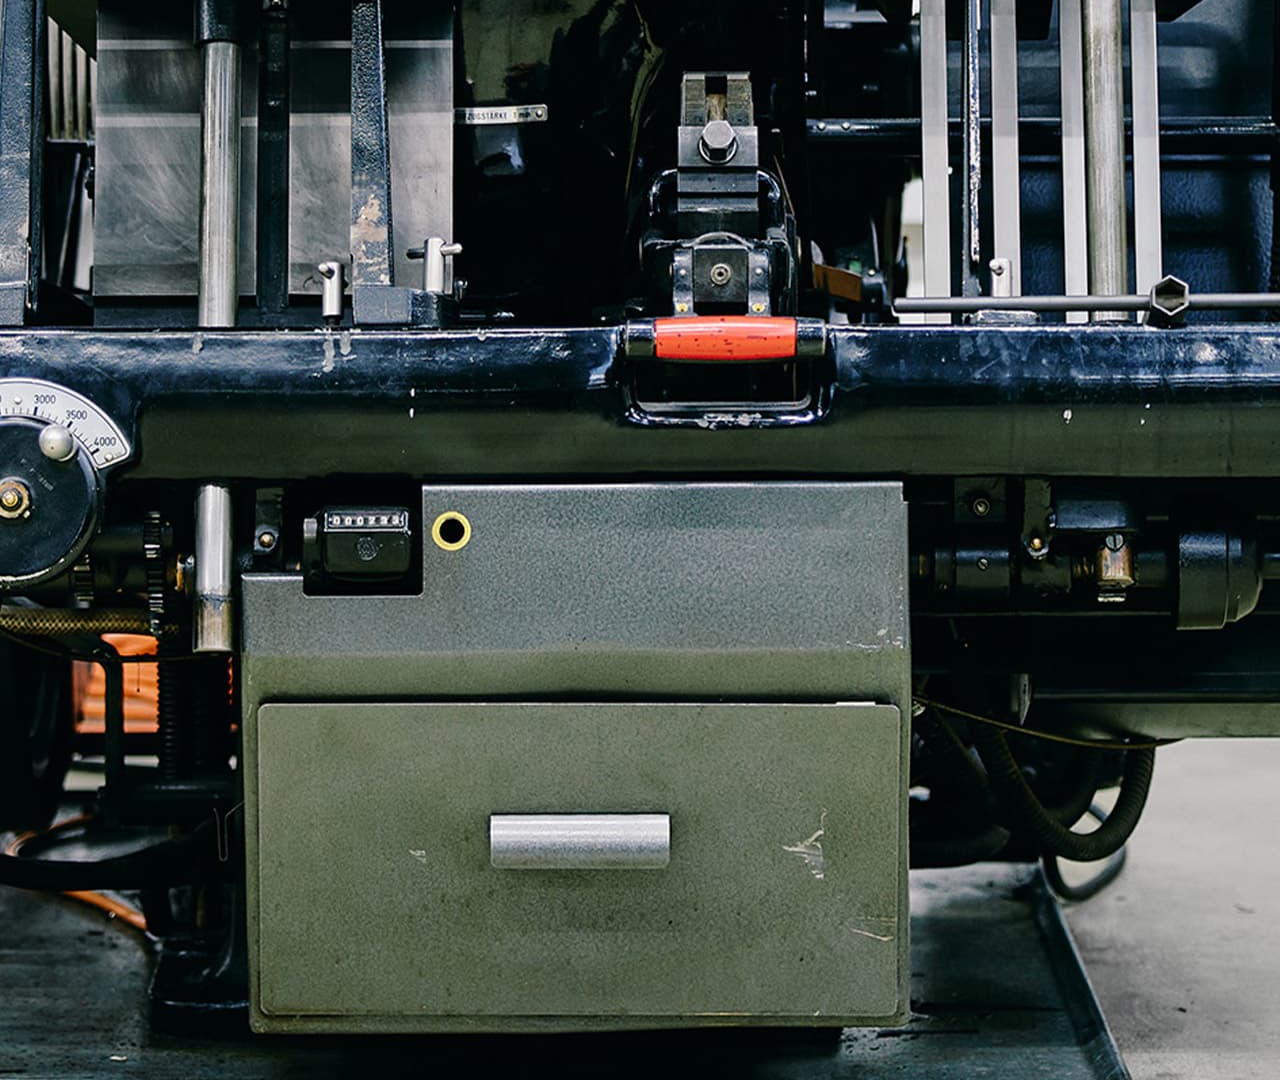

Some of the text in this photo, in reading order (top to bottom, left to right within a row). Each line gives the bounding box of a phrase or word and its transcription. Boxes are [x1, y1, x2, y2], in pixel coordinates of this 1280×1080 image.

[34, 394, 56, 405] 3000
[66, 410, 88, 420] 3500
[94, 436, 117, 447] 4000
